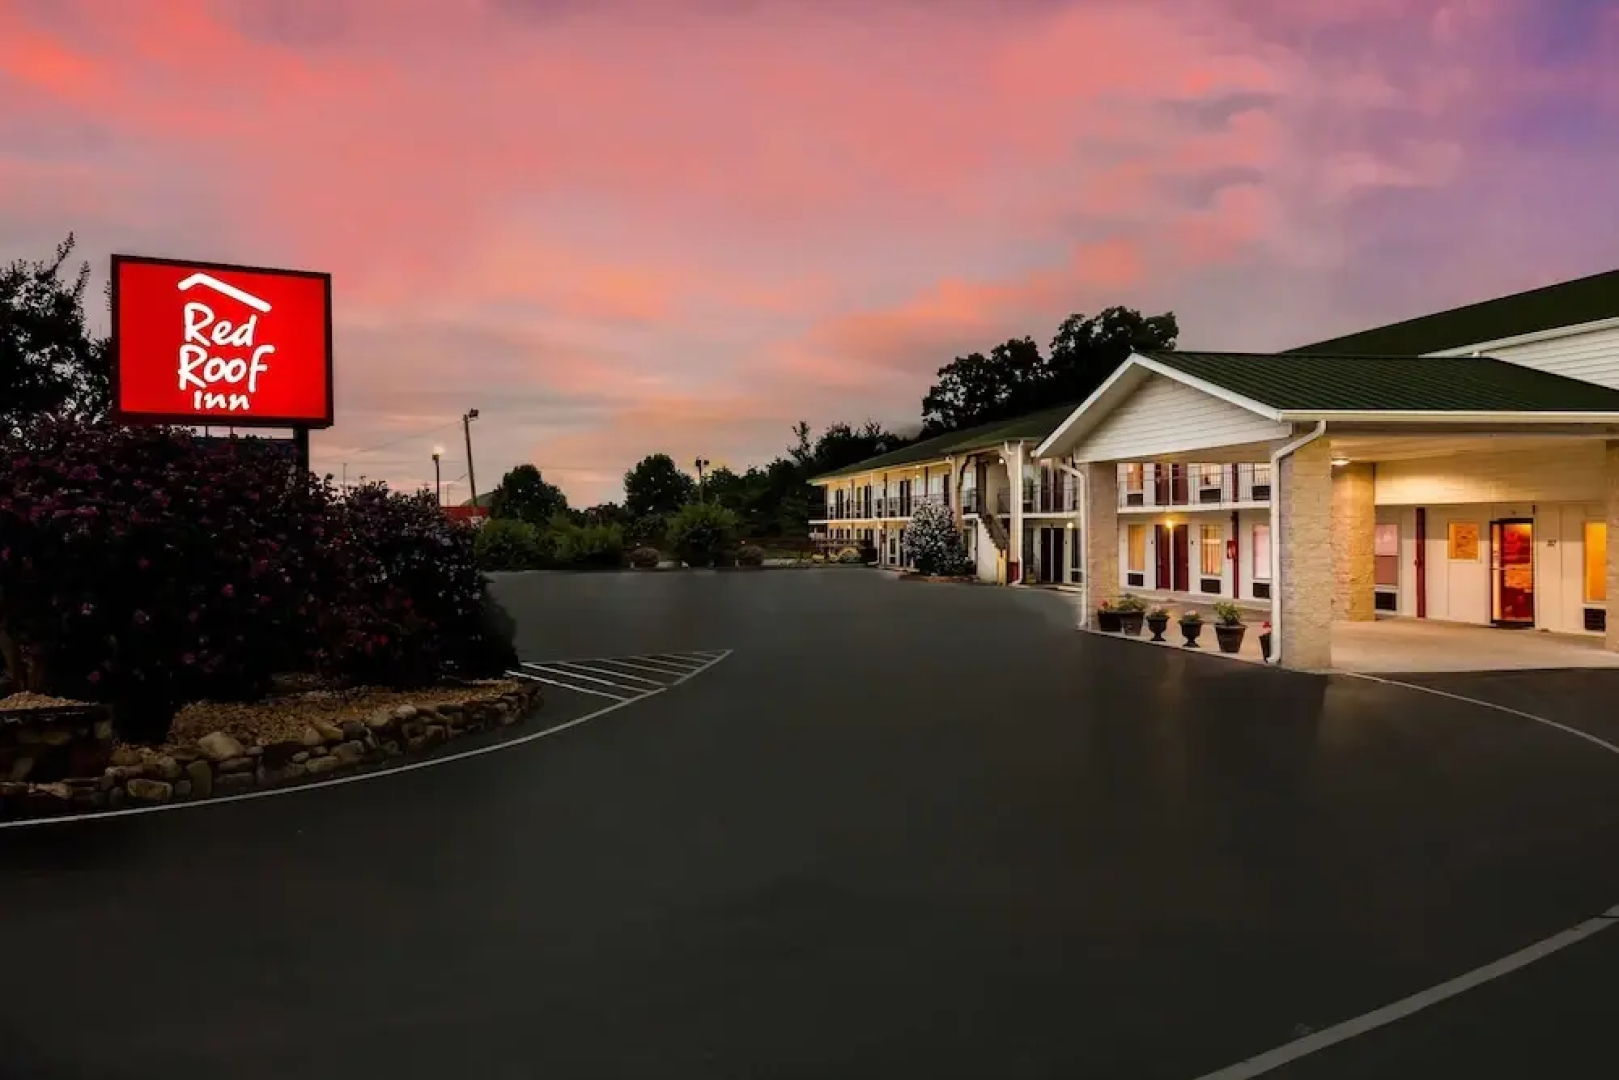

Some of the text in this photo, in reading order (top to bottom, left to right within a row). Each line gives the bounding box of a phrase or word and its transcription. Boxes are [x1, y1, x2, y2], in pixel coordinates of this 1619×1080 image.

[183, 303, 257, 347] Red
[178, 344, 275, 392] Roof
[193, 390, 250, 411] Inn
